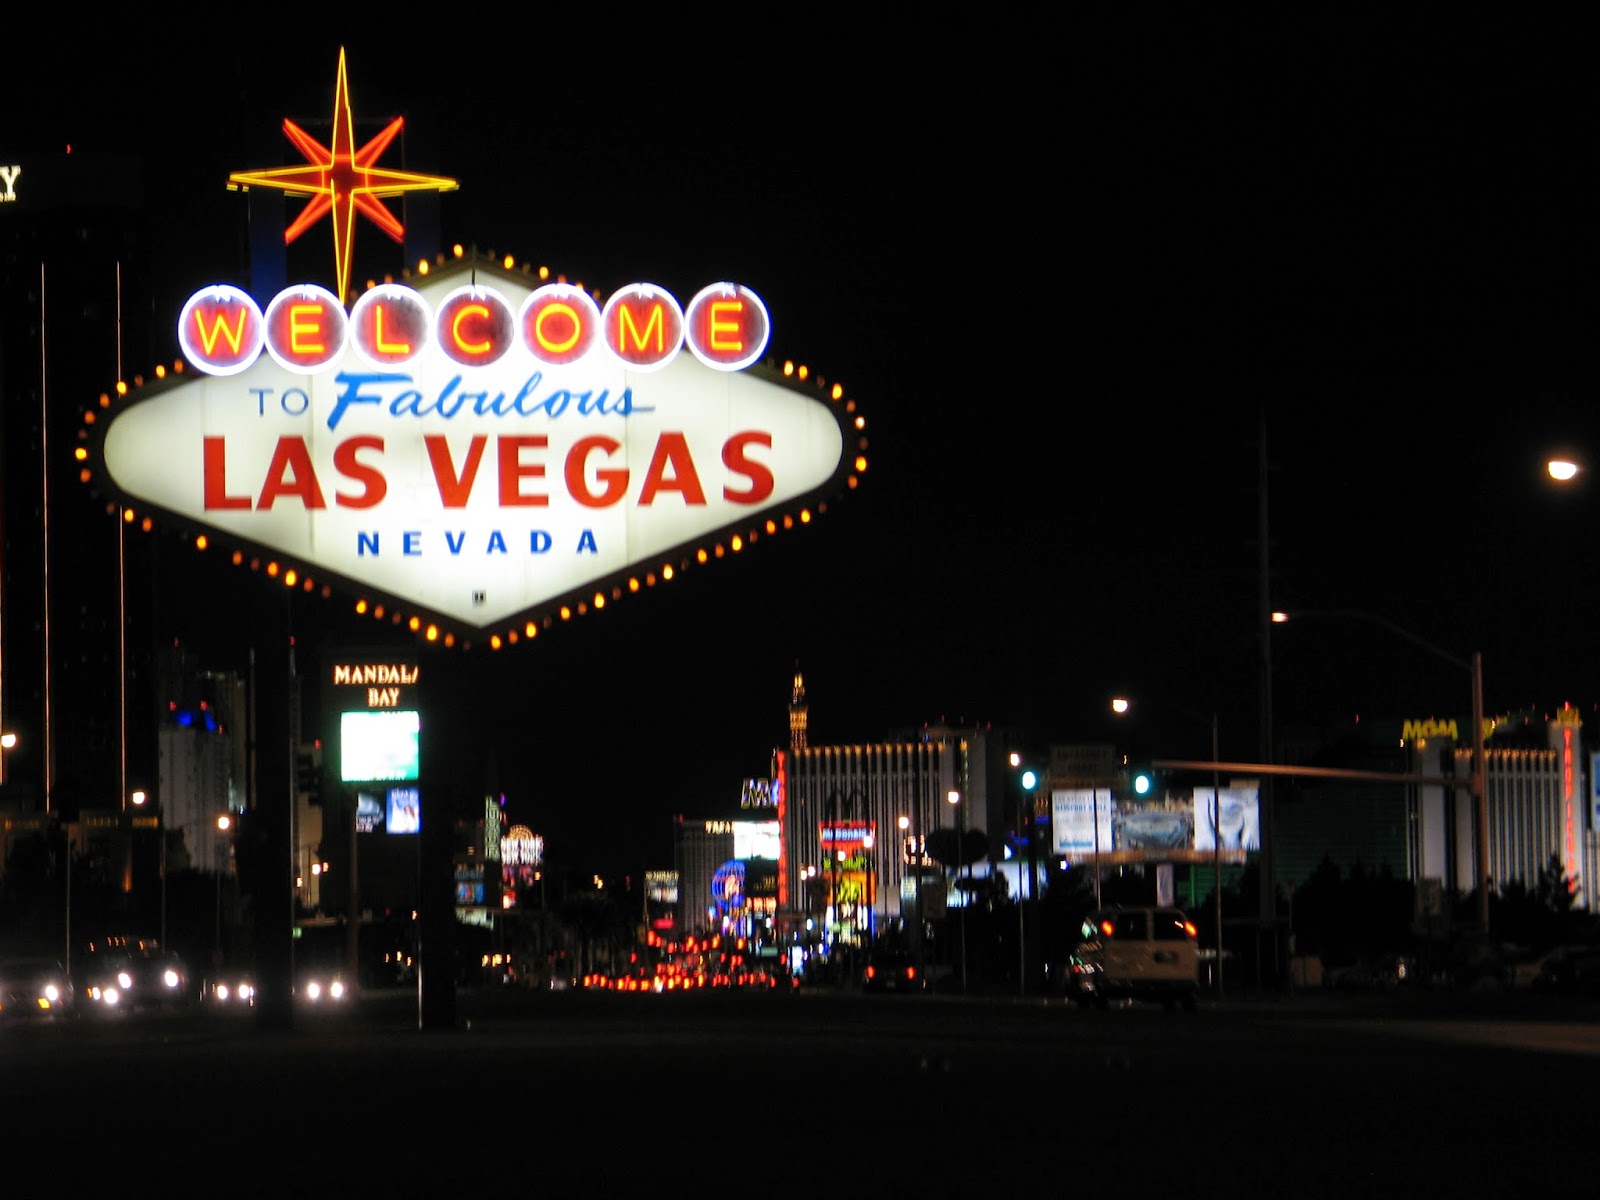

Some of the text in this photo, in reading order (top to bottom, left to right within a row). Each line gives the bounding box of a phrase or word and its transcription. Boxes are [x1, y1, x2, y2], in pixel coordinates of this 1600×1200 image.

[194, 301, 744, 356] WELCOME
[249, 371, 656, 432] TO Fabulous
[202, 430, 775, 512] LAS VEGAS
[357, 528, 600, 556] NEVADA
[366, 687, 401, 707] BAY
